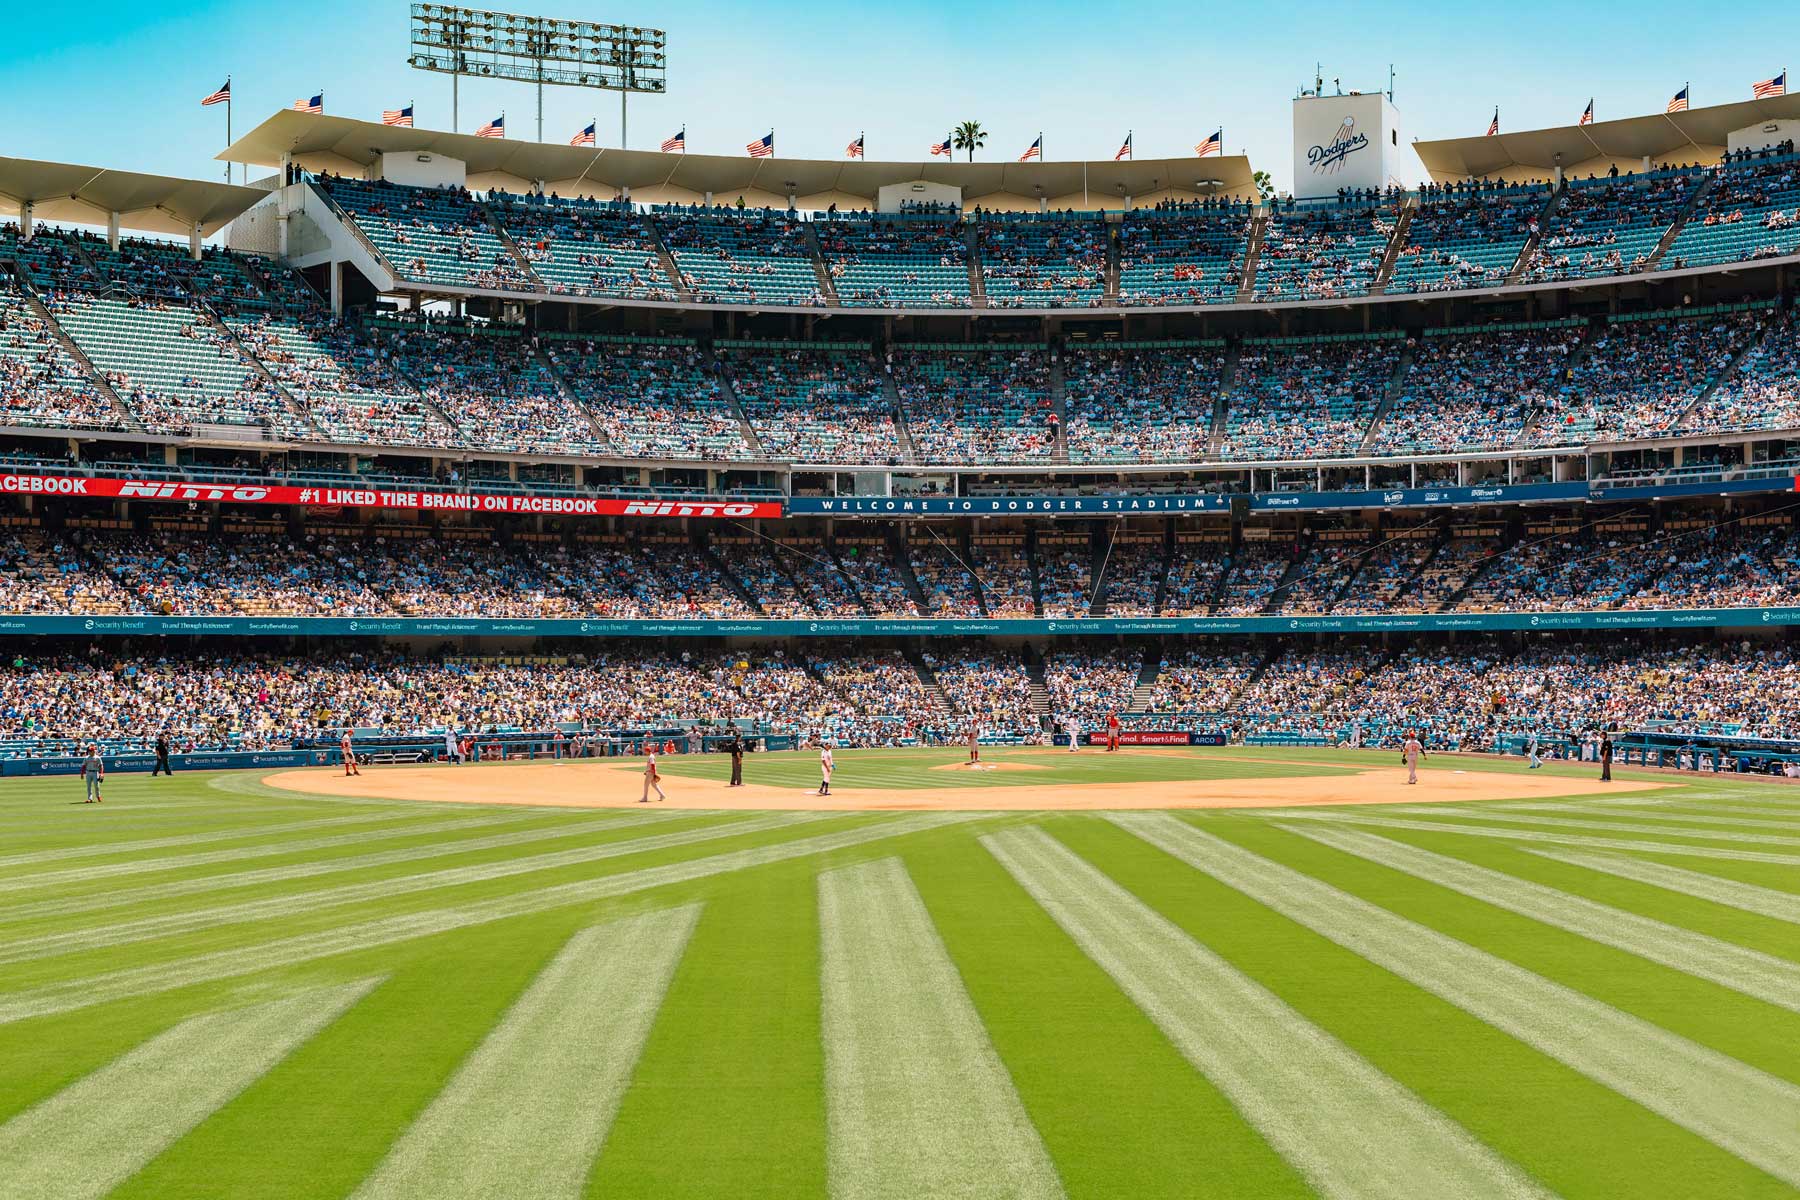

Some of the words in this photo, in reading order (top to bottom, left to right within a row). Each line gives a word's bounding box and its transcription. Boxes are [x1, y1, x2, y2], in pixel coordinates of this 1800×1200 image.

[1307, 132, 1369, 167] Dodgers
[0, 476, 87, 494] CEBOOK
[118, 481, 267, 501] NITTO
[299, 488, 320, 503] #1
[327, 489, 376, 505] LIKED
[380, 491, 418, 507] TIRE
[422, 493, 479, 509] BRAND
[484, 495, 507, 510] ON
[512, 497, 598, 513] FACEBOOK
[623, 501, 754, 517] NITTO
[822, 501, 928, 510] WELCOME
[948, 501, 971, 510] TO
[992, 501, 1082, 510] DODGER
[1102, 499, 1204, 509] STADIUM
